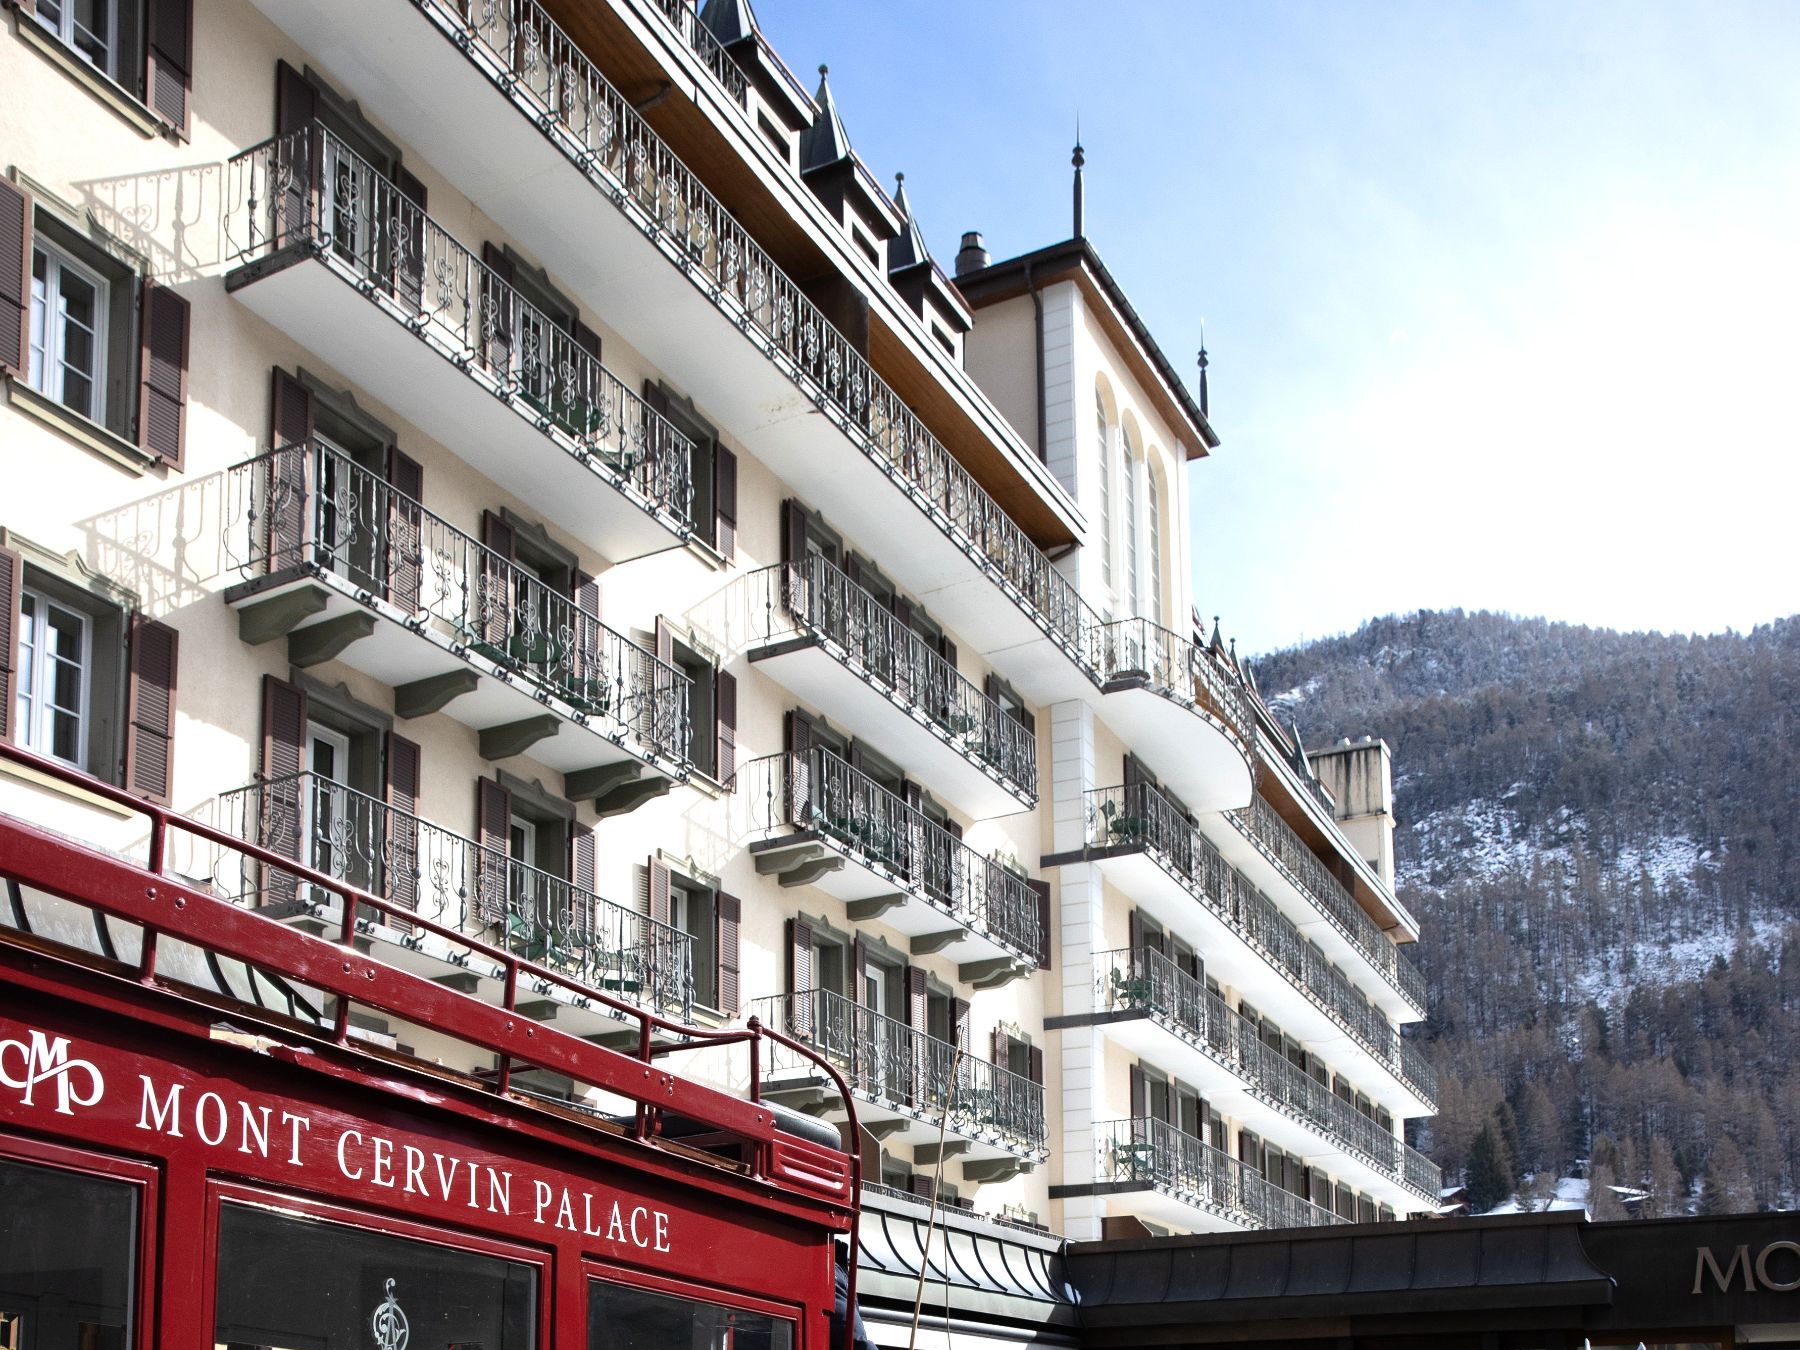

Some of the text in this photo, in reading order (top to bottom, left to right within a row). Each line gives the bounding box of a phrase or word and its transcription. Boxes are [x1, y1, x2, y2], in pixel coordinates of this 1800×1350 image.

[136, 1074, 671, 1252] MONT CERVIN PALACE
